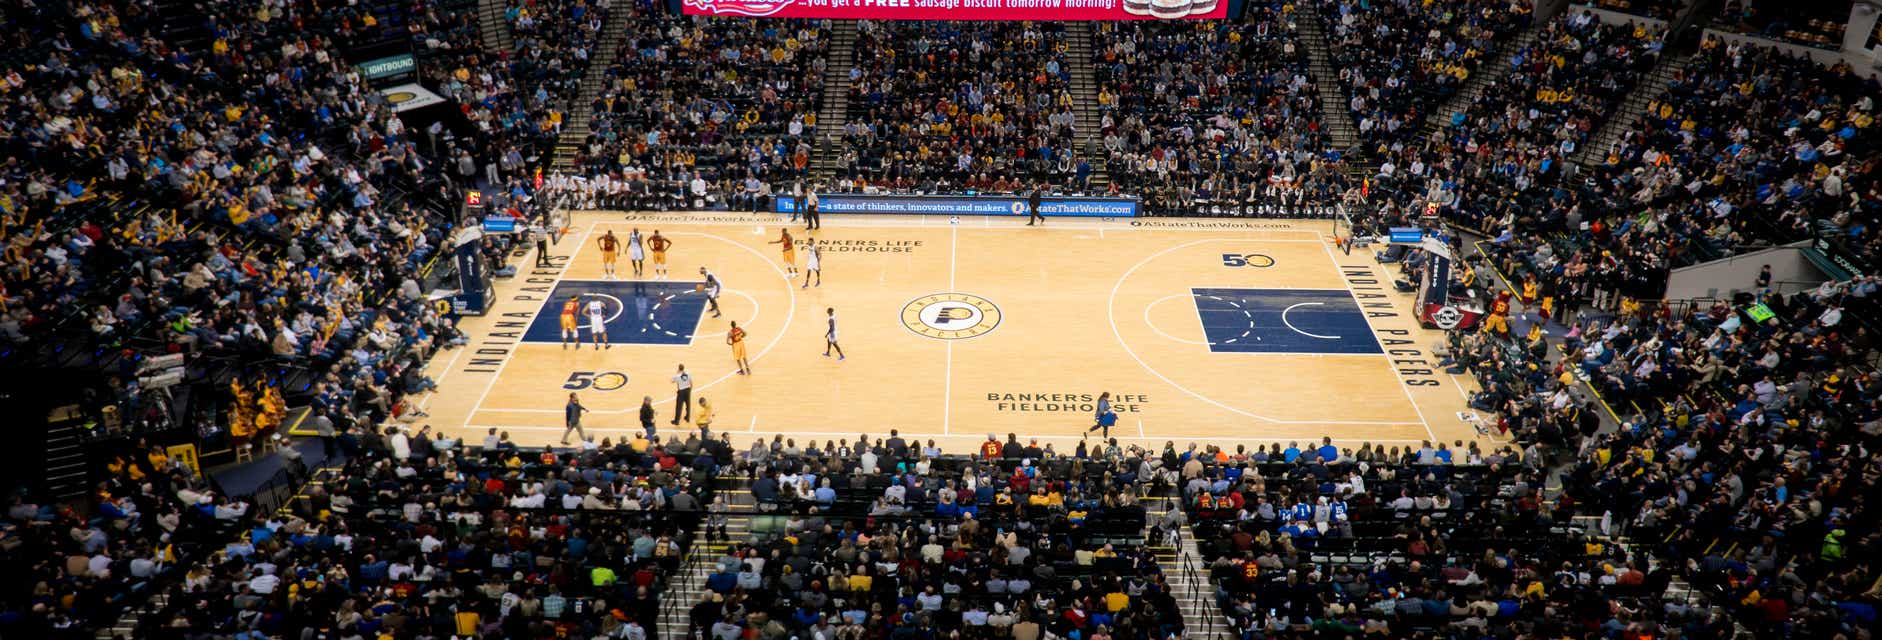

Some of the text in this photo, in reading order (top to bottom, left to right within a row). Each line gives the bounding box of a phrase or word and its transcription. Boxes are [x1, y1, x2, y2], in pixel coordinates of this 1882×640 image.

[914, 0, 960, 9] sausage
[1006, 0, 1060, 8] tomorrow
[1065, 0, 1116, 9] morning!
[856, 202, 866, 210] of
[907, 203, 955, 211] innovators
[956, 203, 972, 211] and
[974, 203, 1009, 212] makers.
[1340, 264, 1441, 387] INDIANA PACERS
[464, 311, 534, 373] INDIANA
[562, 371, 629, 391] 50
[987, 392, 1093, 403] BANKERS
[998, 402, 1141, 413] FIELDHOSE
[1246, 568, 1258, 577] 33
